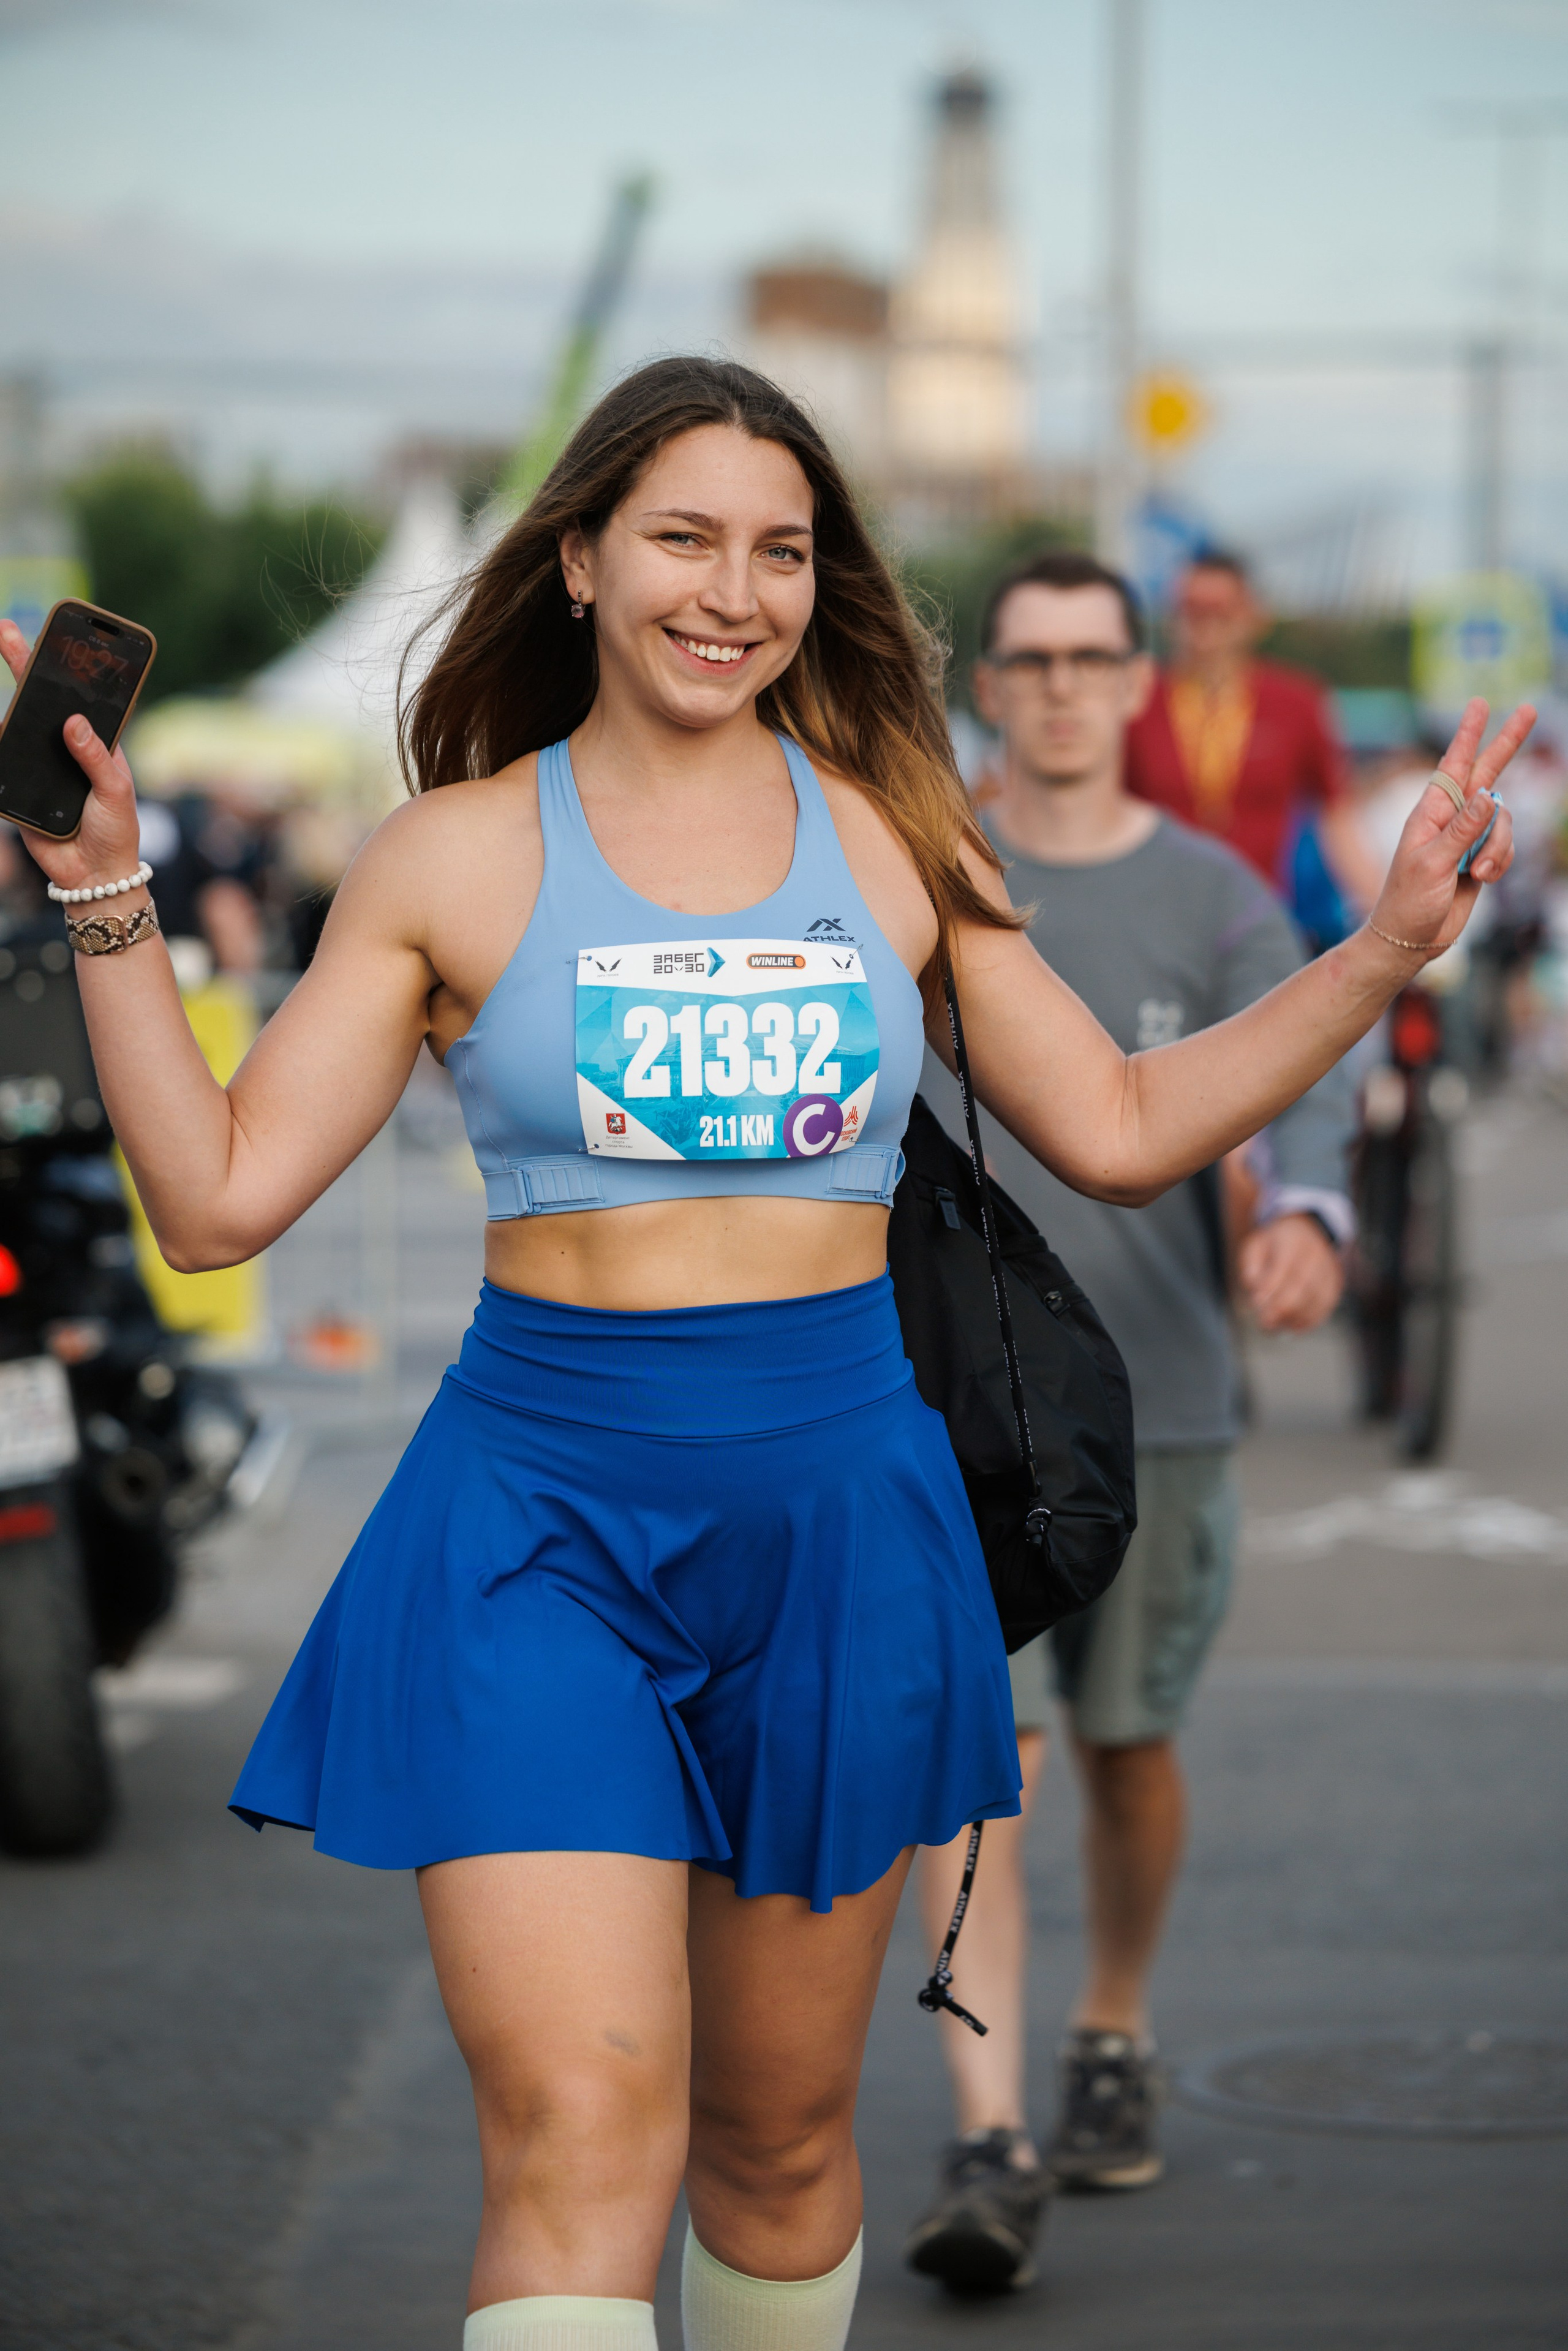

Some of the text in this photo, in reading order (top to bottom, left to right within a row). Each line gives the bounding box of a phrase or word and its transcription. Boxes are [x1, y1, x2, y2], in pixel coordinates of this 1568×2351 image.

[653, 953, 704, 964] ЗАБЕГ
[751, 956, 794, 966] WINLINE
[946, 1002, 959, 1050] ATHLEX
[624, 1002, 842, 1098] 21332
[957, 1071, 970, 1119] ATHLEX
[699, 1115, 737, 1147] 21.1
[840, 1128, 858, 1136] ОСКОВСКИЙ
[965, 1827, 979, 1873] ATHLEX
[950, 1890, 968, 1934] ATHLEX
